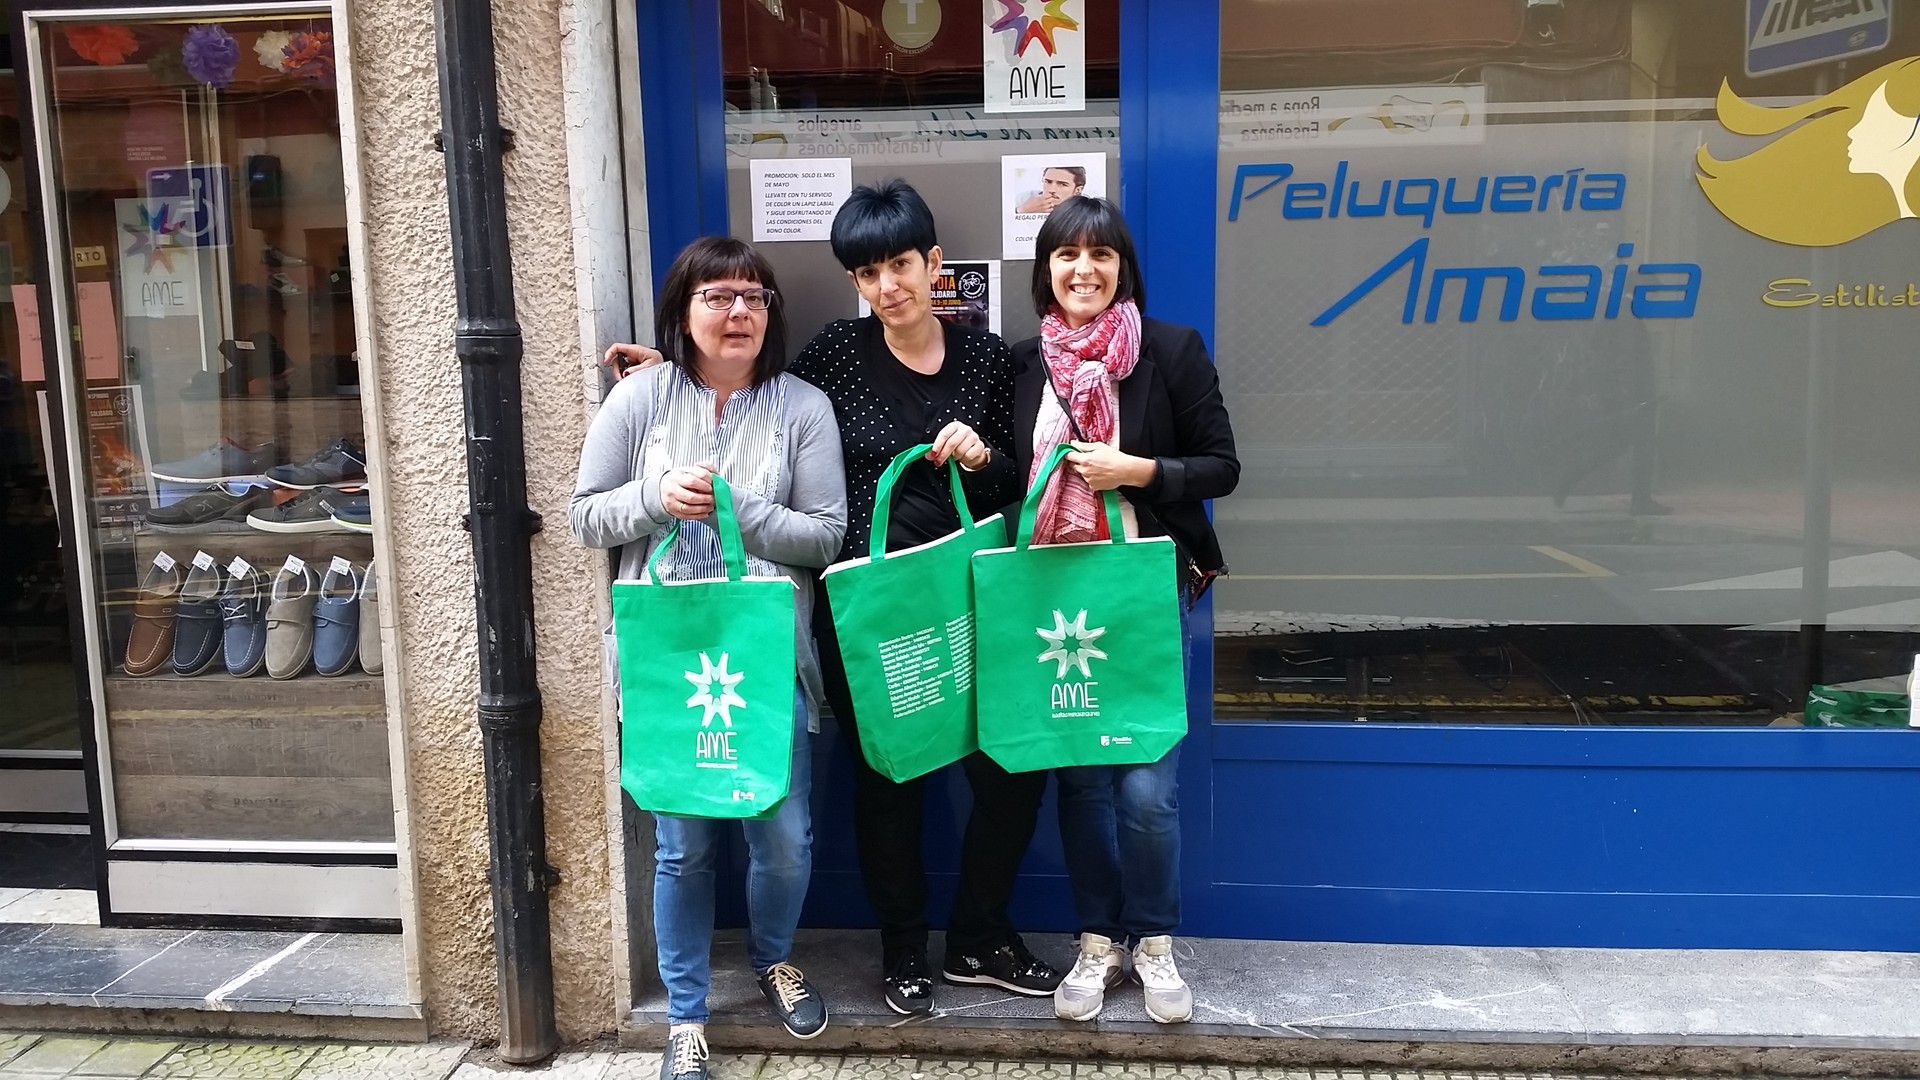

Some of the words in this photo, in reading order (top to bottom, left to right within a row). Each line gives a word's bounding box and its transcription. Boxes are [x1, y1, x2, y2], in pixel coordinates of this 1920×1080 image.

[1009, 65, 1066, 100] AME
[1228, 160, 1627, 228] Peluquería
[141, 280, 185, 307] AME
[1308, 237, 1702, 326] Amaia
[1051, 682, 1099, 709] AME
[696, 731, 737, 760] AME
